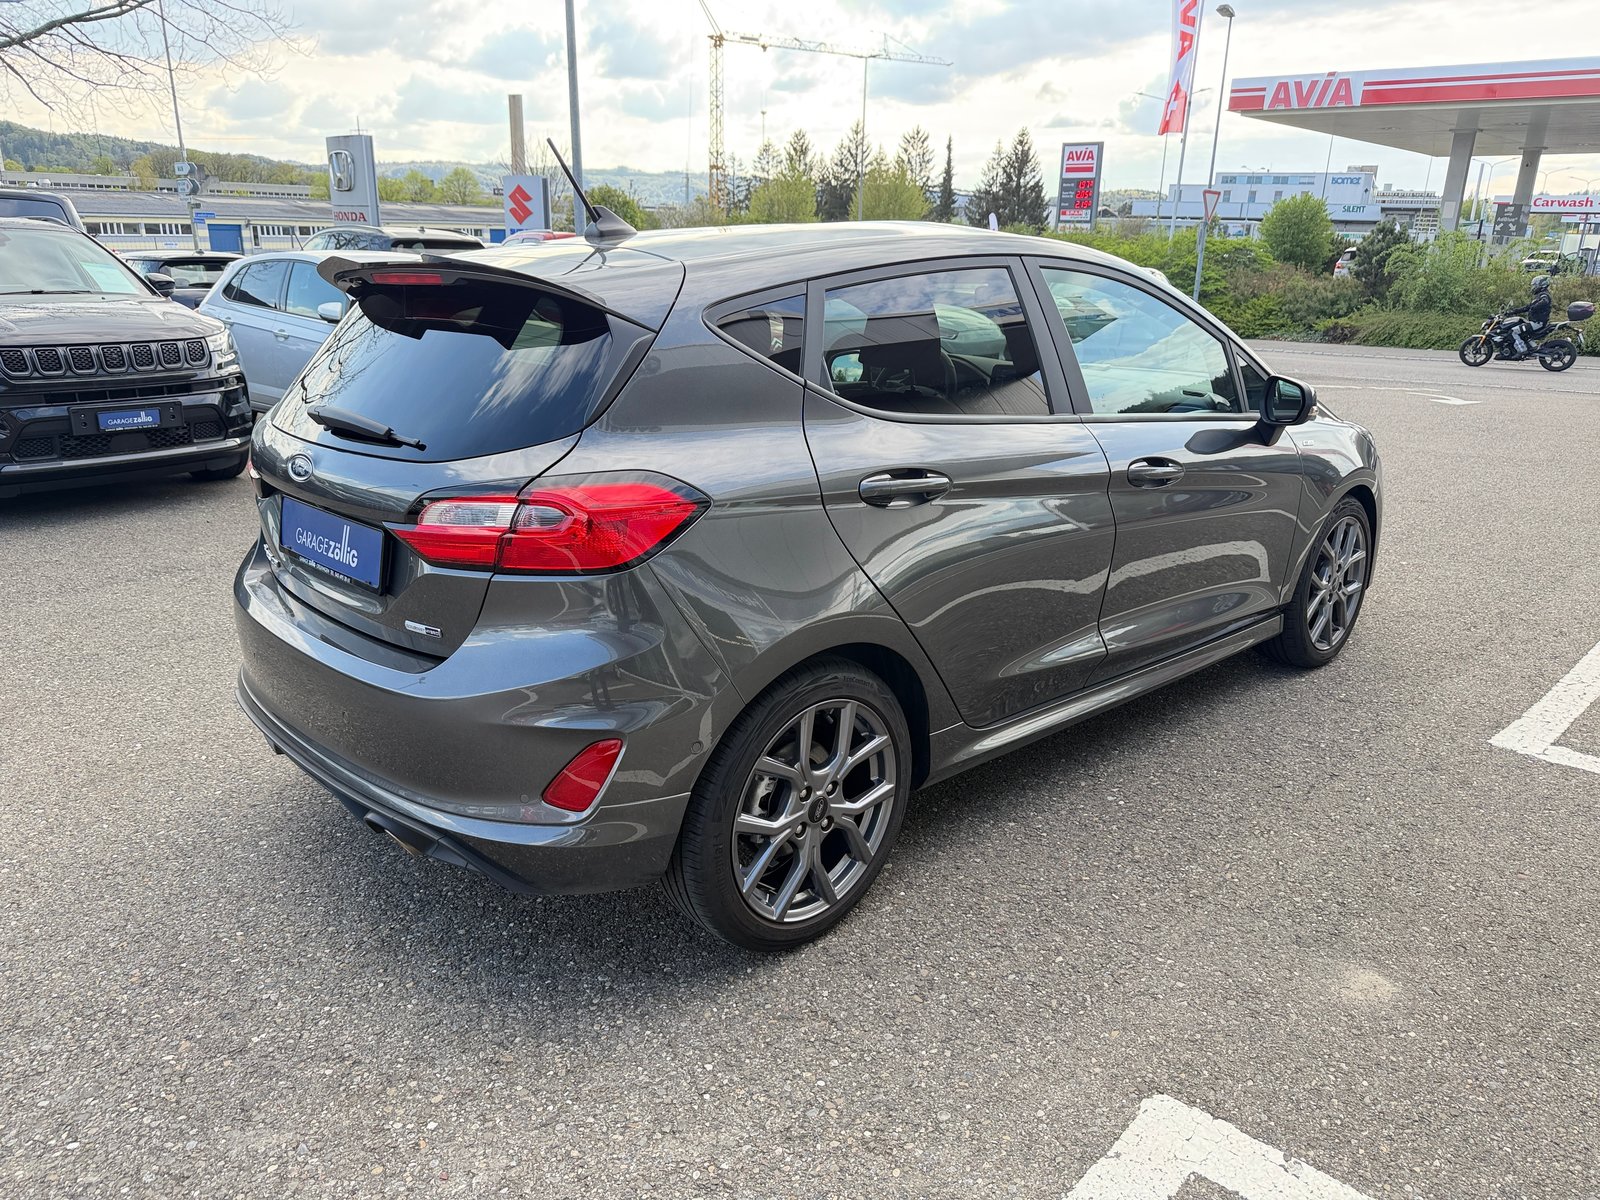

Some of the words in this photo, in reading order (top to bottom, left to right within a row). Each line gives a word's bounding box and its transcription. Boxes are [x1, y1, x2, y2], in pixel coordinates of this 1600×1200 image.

[1268, 71, 1353, 109] AVIA
[1066, 147, 1095, 162] AVIA
[1533, 197, 1593, 208] Carwash
[333, 211, 367, 222] HONDA
[108, 417, 133, 426] GARAGE
[295, 527, 328, 555] GARAGE
